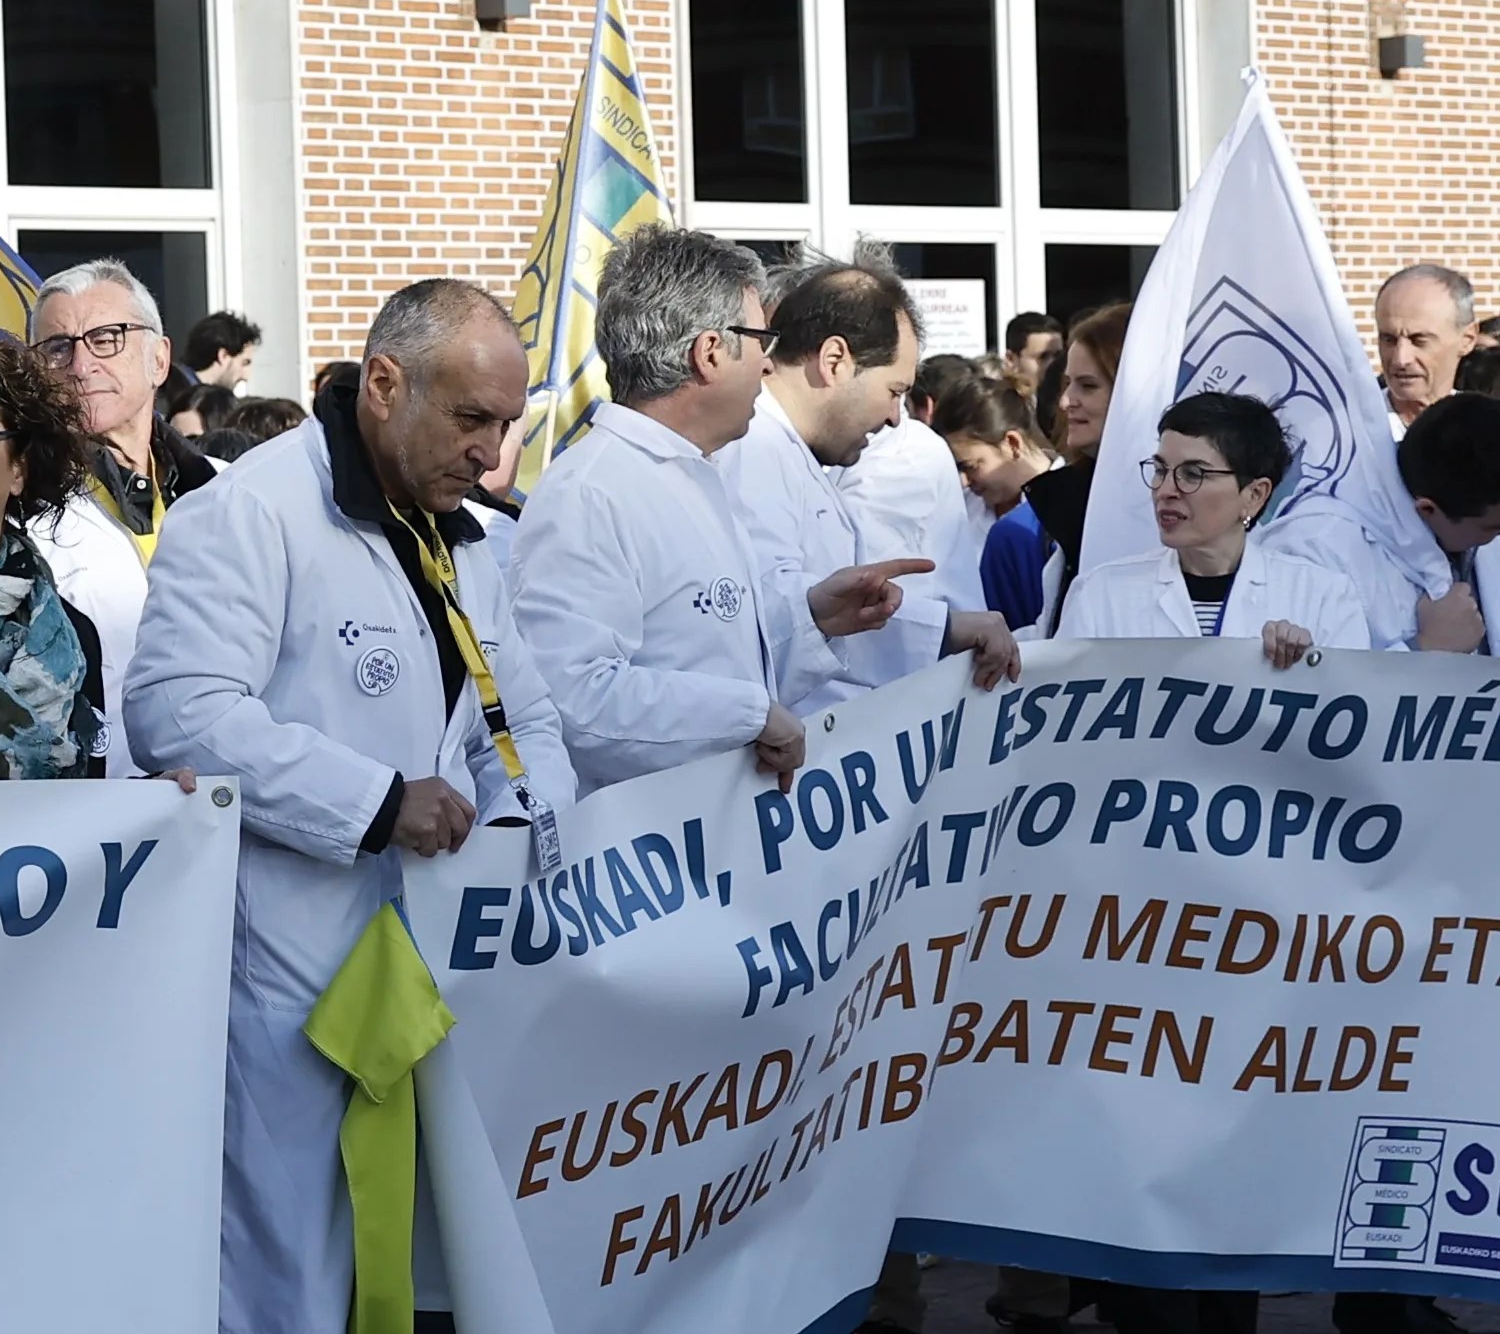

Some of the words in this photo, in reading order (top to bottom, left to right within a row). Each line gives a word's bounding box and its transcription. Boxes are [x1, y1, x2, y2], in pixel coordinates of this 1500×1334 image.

[597, 95, 655, 164] SINDICA
[449, 818, 732, 971] EUSKADI,
[753, 749, 889, 876] POR
[988, 676, 1369, 766] ESTATUTO
[1090, 778, 1403, 864] PROPIO
[96, 839, 160, 931] Y
[1082, 894, 1402, 985] MEDIKO
[600, 1051, 941, 1288] FAKULTATIB
[937, 999, 1215, 1085] BATEN
[1232, 1025, 1420, 1093] ALDE
[1377, 1144, 1423, 1156] SINDICATO
[1365, 1232, 1403, 1243] EUSKADI
